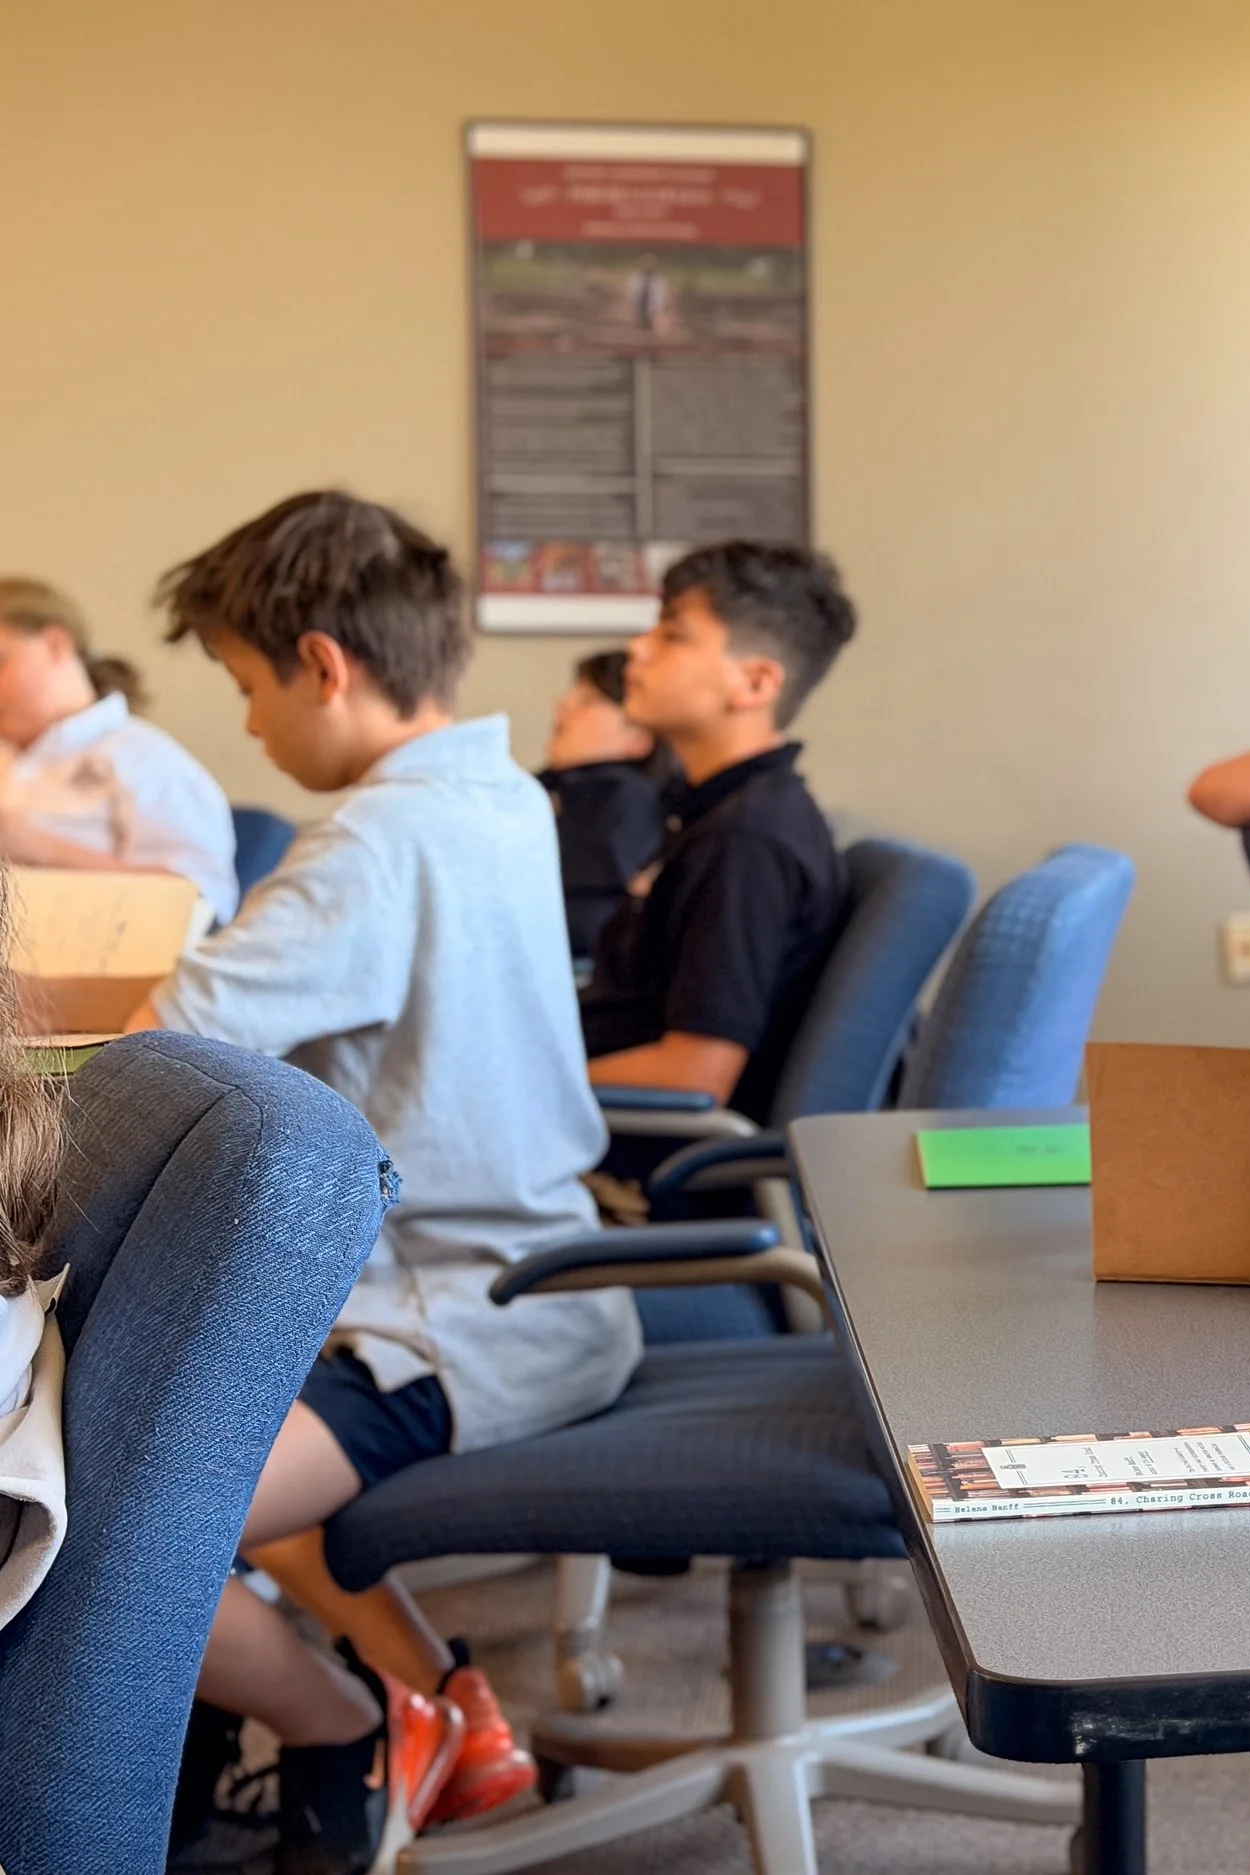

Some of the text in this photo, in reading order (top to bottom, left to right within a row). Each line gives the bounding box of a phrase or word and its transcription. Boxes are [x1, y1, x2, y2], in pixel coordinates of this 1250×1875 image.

[1110, 1496, 1129, 1506] 84,
[1136, 1494, 1184, 1504] Charing
[1189, 1492, 1223, 1501] Cross
[954, 1503, 1020, 1514] Helene Hanff
